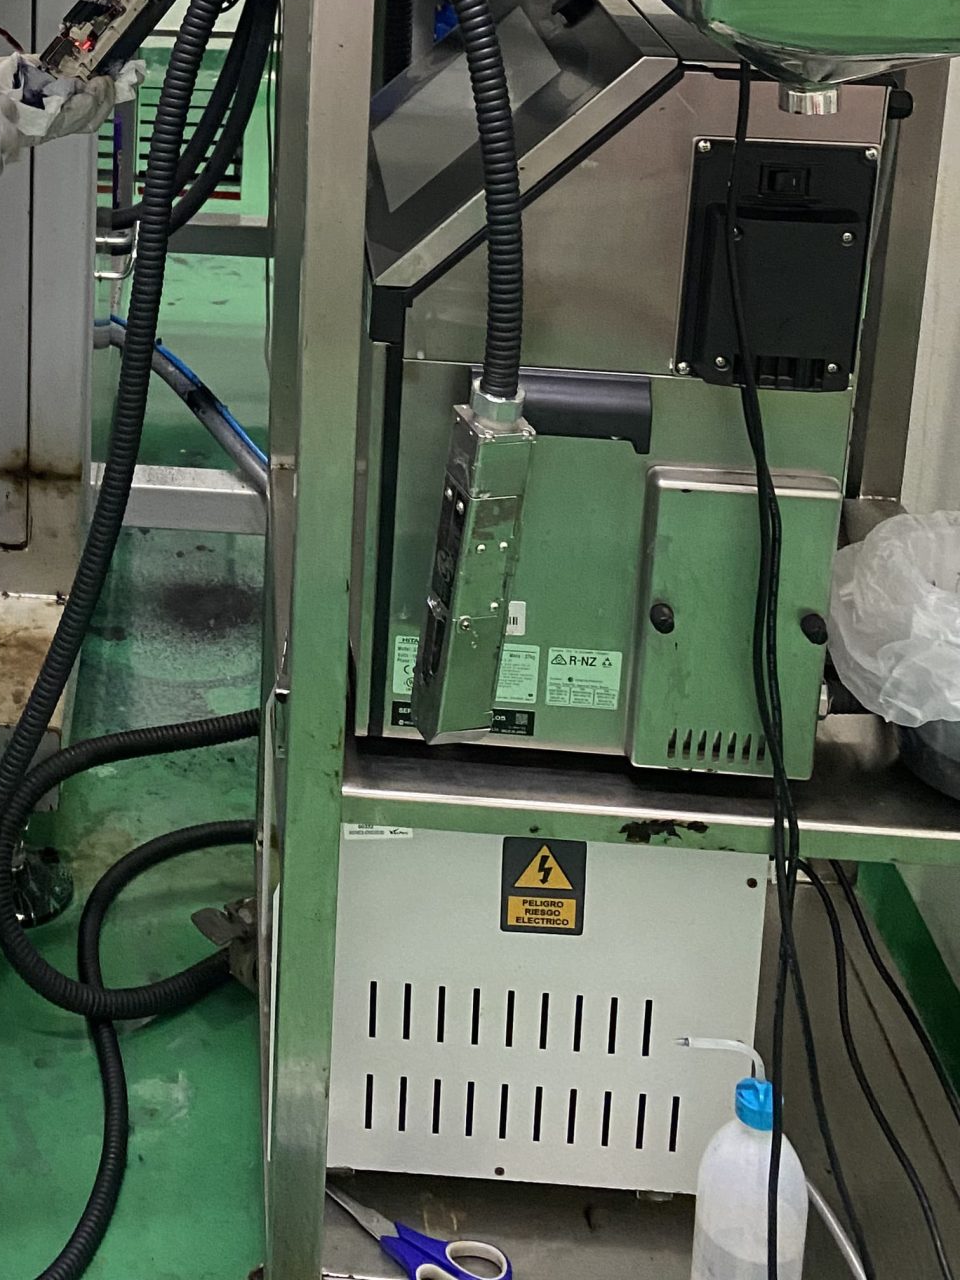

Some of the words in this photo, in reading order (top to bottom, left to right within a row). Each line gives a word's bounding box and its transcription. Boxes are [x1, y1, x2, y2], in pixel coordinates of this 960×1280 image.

[569, 655, 597, 667] R-NZ
[522, 899, 564, 909] PELIGRO
[524, 908, 561, 917] RIESGO
[515, 917, 569, 926] ELECTRICO
